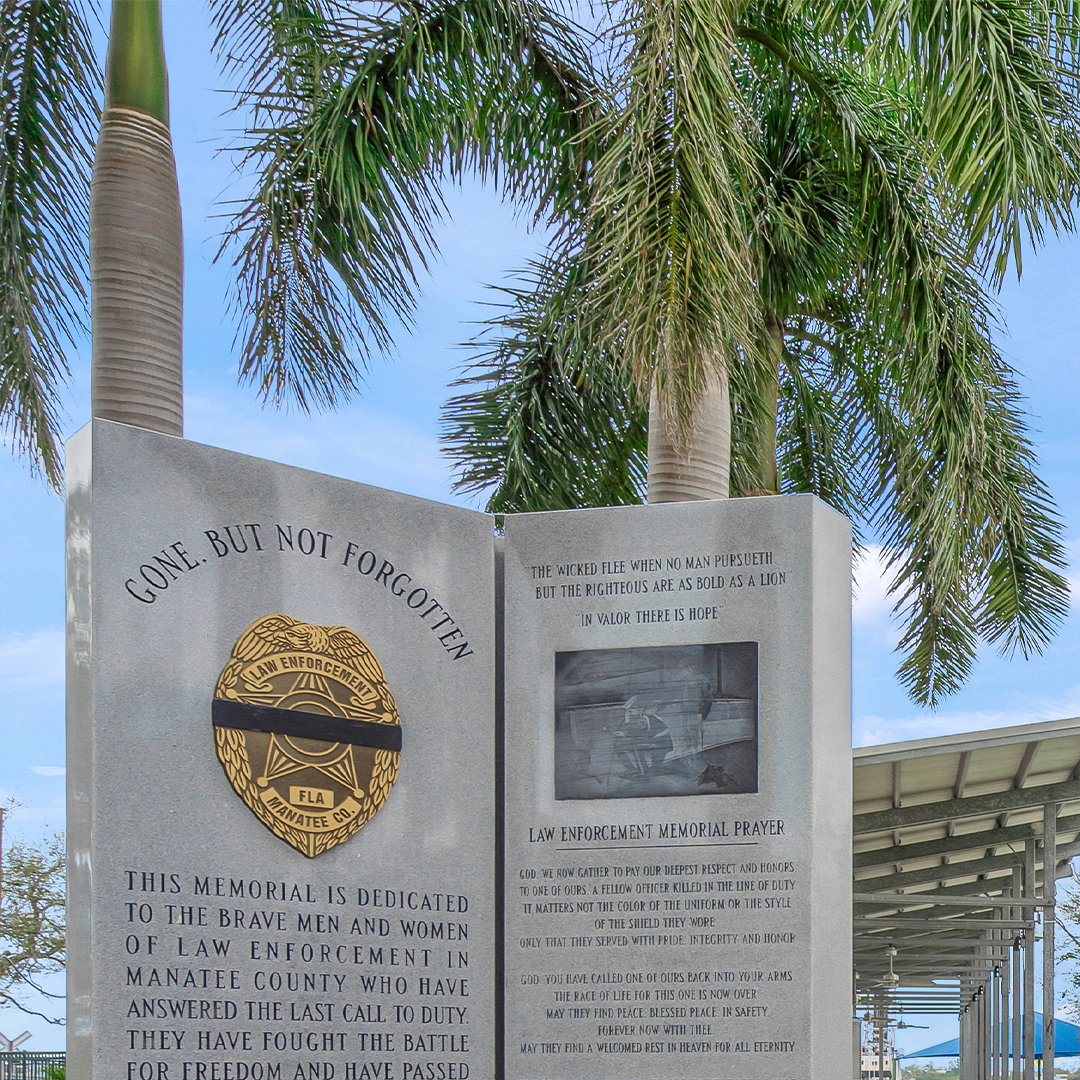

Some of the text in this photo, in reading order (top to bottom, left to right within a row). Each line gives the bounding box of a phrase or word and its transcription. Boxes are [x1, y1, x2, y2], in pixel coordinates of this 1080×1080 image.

[557, 562, 597, 577] WICKED
[601, 561, 625, 574] FLEE
[630, 559, 661, 573] WHEN
[666, 557, 681, 571] NO
[685, 556, 709, 570] MAN
[204, 523, 263, 558] BUT
[277, 525, 333, 559] NOT
[340, 542, 473, 662] FORGOTTEN
[535, 585, 555, 599] BUT
[561, 584, 580, 597] THE
[584, 580, 647, 596] RIGHTEOUS
[653, 579, 673, 593] ARE
[678, 577, 692, 591] AS
[696, 576, 724, 590] BOLD
[729, 575, 742, 588] AS
[748, 574, 754, 587] A
[597, 611, 630, 625] VALOR
[636, 609, 669, 624] THERE
[674, 608, 684, 622] IS
[248, 656, 371, 699] LAW ENFORCEMENT
[299, 789, 325, 804] FLA
[266, 796, 356, 828] MANATEE CO.
[529, 820, 785, 842] LAW ENFORCEMENT MEMORIAL PRAYER
[124, 871, 469, 912] THIS MEMORIAL IS DEDICATED
[125, 903, 469, 940] TO THE BRAVE MEN AND WOMEN
[126, 935, 469, 968] OF LAW ENFORCEMENT IN
[126, 967, 469, 996] MANATEE COUNTY WHO HAVE
[127, 1000, 469, 1024] ANSWERED THE LAST CALL TO DUTY.
[127, 1031, 469, 1052] THEY HAVE FOUGHT THE BATTLE
[127, 1062, 469, 1080] FOR FREEDOM AND HAVE PASSED
